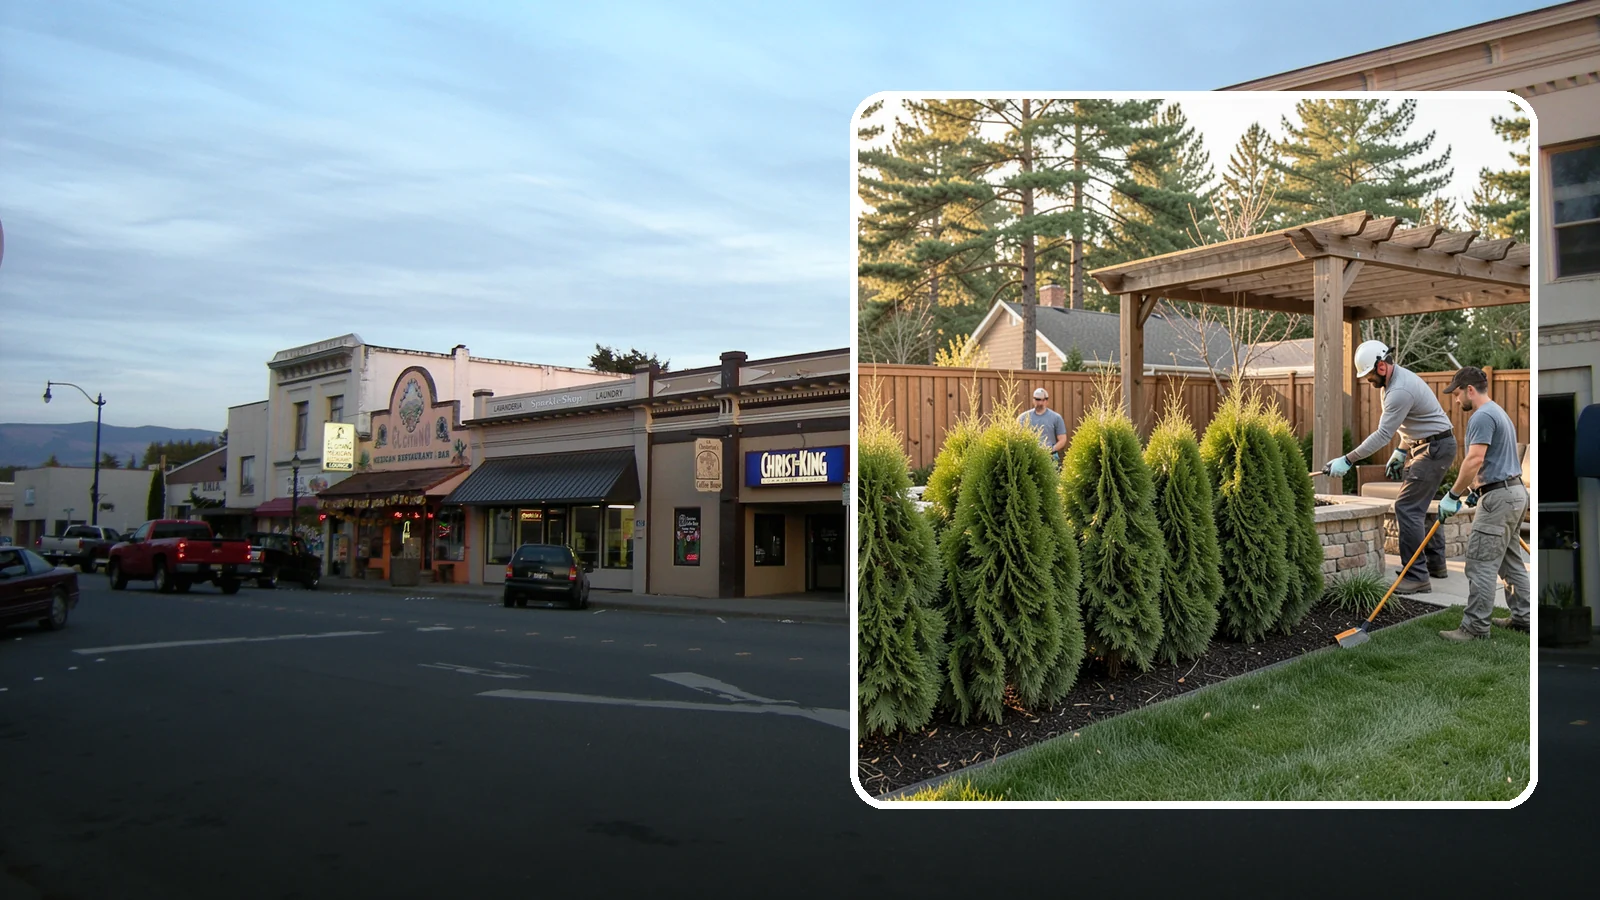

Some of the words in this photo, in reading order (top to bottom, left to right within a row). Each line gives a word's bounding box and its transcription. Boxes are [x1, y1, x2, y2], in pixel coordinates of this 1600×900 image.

[494, 402, 523, 413] LAVANDERIA
[561, 395, 583, 407] Shop
[595, 389, 623, 400] LAUNDRY
[373, 454, 396, 464] MEXICAN
[397, 451, 433, 462] RESTAURANT
[438, 450, 449, 459] BAR
[761, 452, 796, 478] CHRIST
[799, 450, 828, 476] KING
[697, 480, 709, 489] Coffee
[710, 480, 721, 489] House
